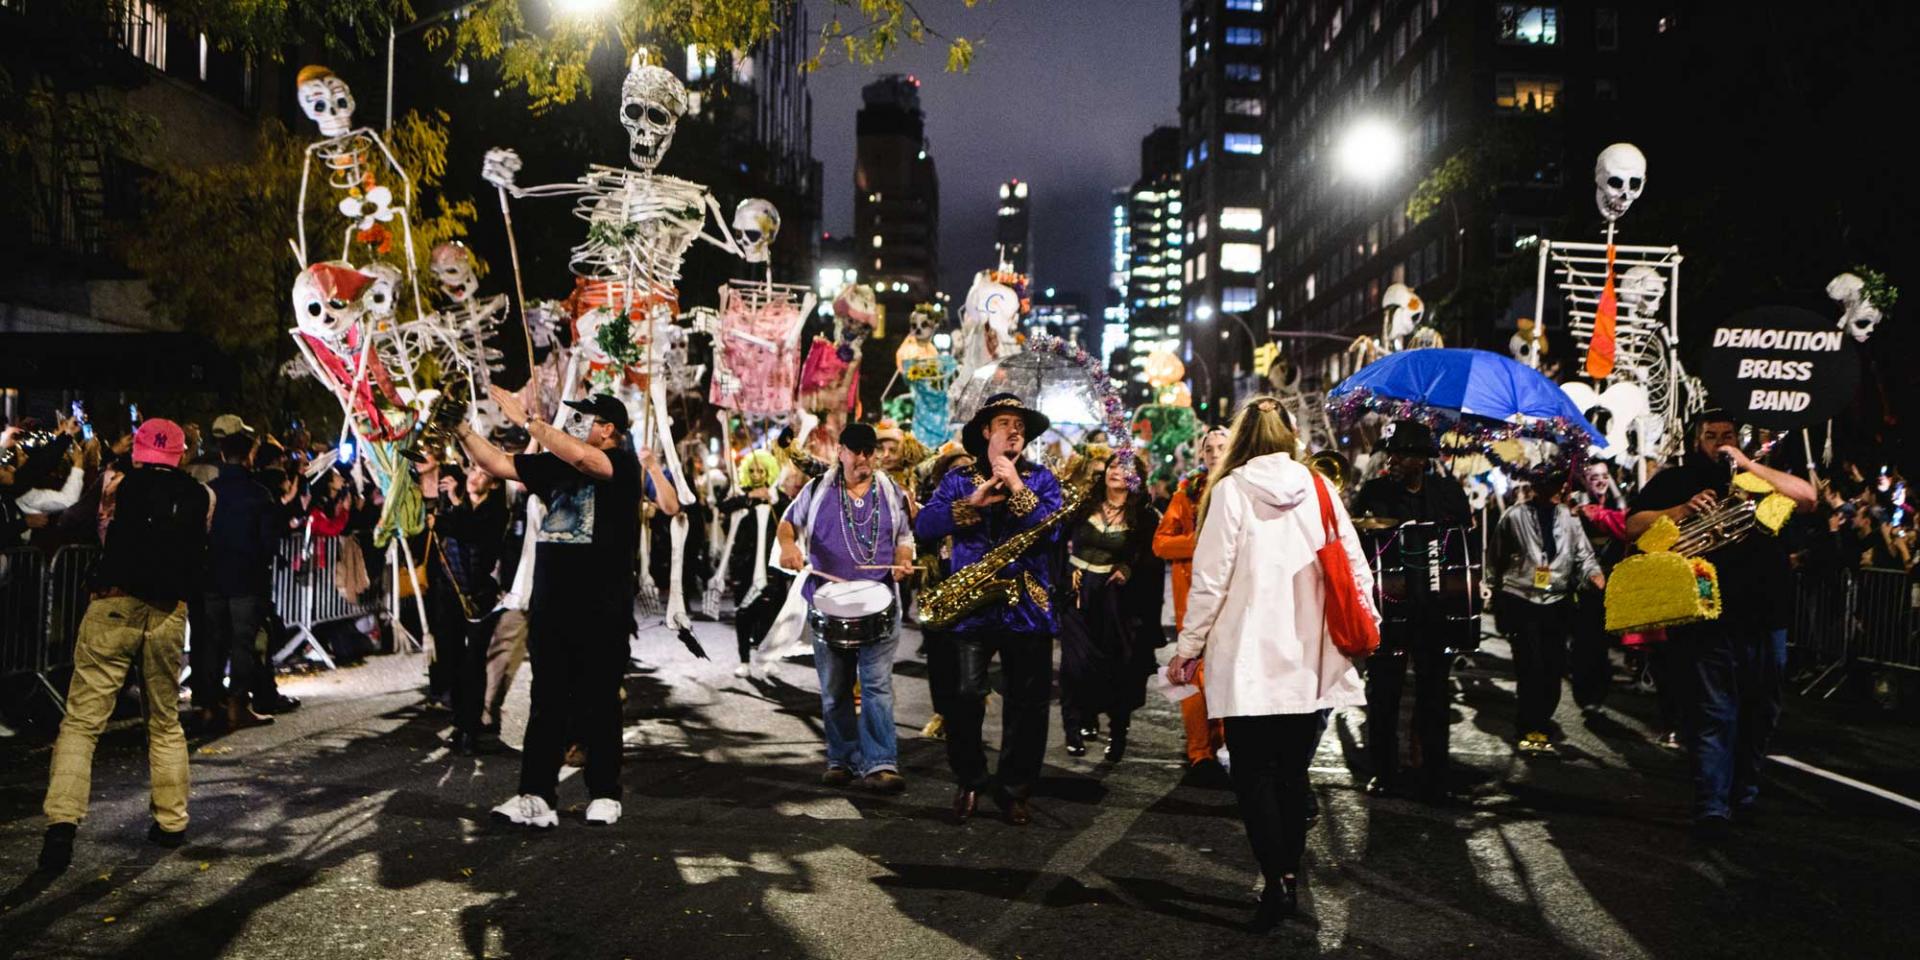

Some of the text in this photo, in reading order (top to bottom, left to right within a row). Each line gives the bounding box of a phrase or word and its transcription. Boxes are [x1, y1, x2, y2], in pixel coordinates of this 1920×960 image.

[1713, 328, 1843, 351] DEMOLITION
[1737, 359, 1814, 381] BRASS
[1749, 390, 1810, 412] BAND
